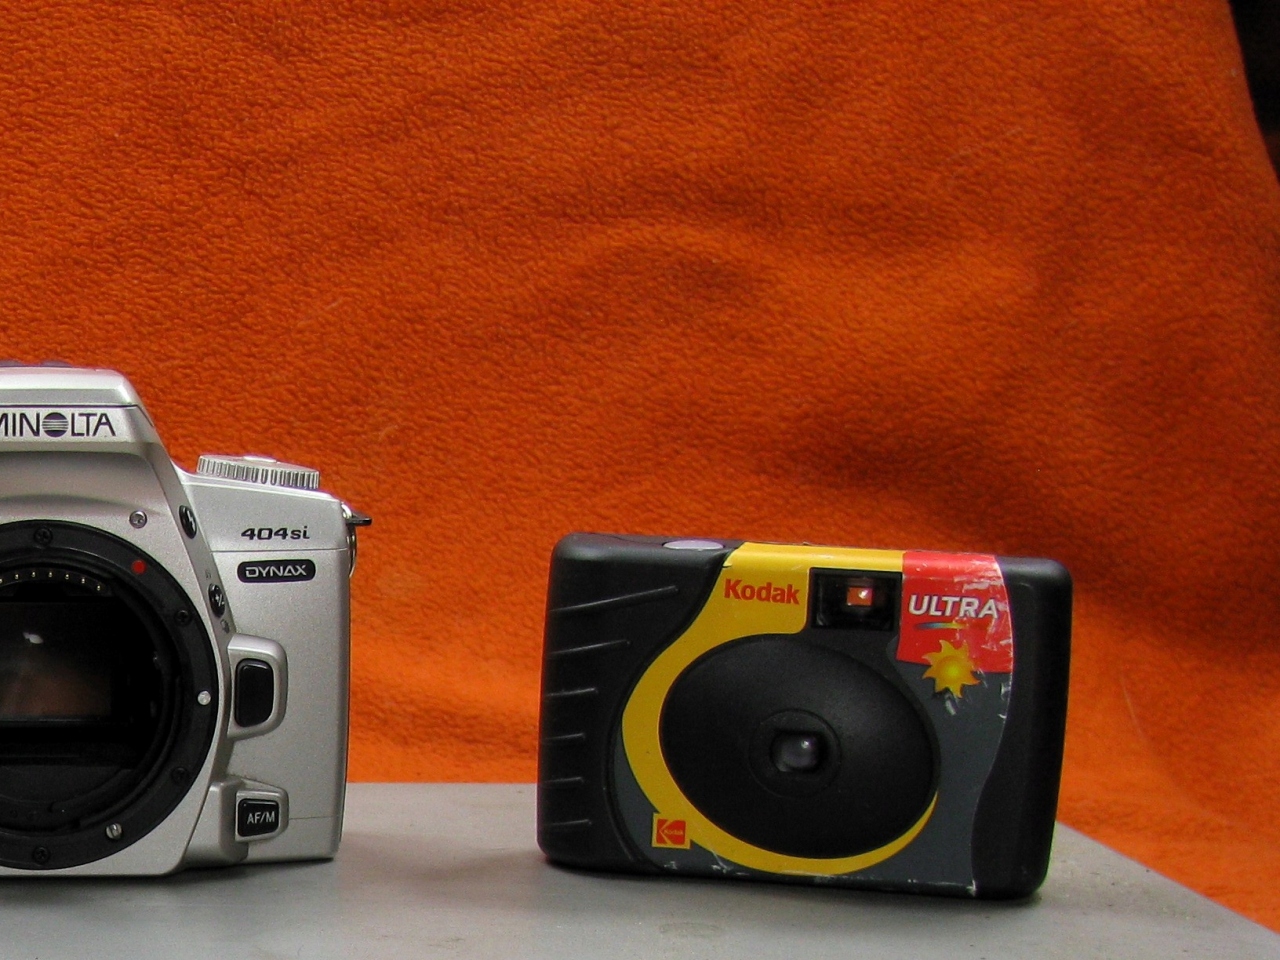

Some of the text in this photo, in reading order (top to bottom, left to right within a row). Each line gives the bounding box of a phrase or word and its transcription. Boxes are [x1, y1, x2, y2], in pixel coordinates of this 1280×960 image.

[241, 525, 310, 541] 404si
[245, 564, 307, 578] DYNAX
[723, 578, 800, 605] Kodak
[908, 593, 1000, 619] ULTRA
[246, 811, 275, 825] AF/M
